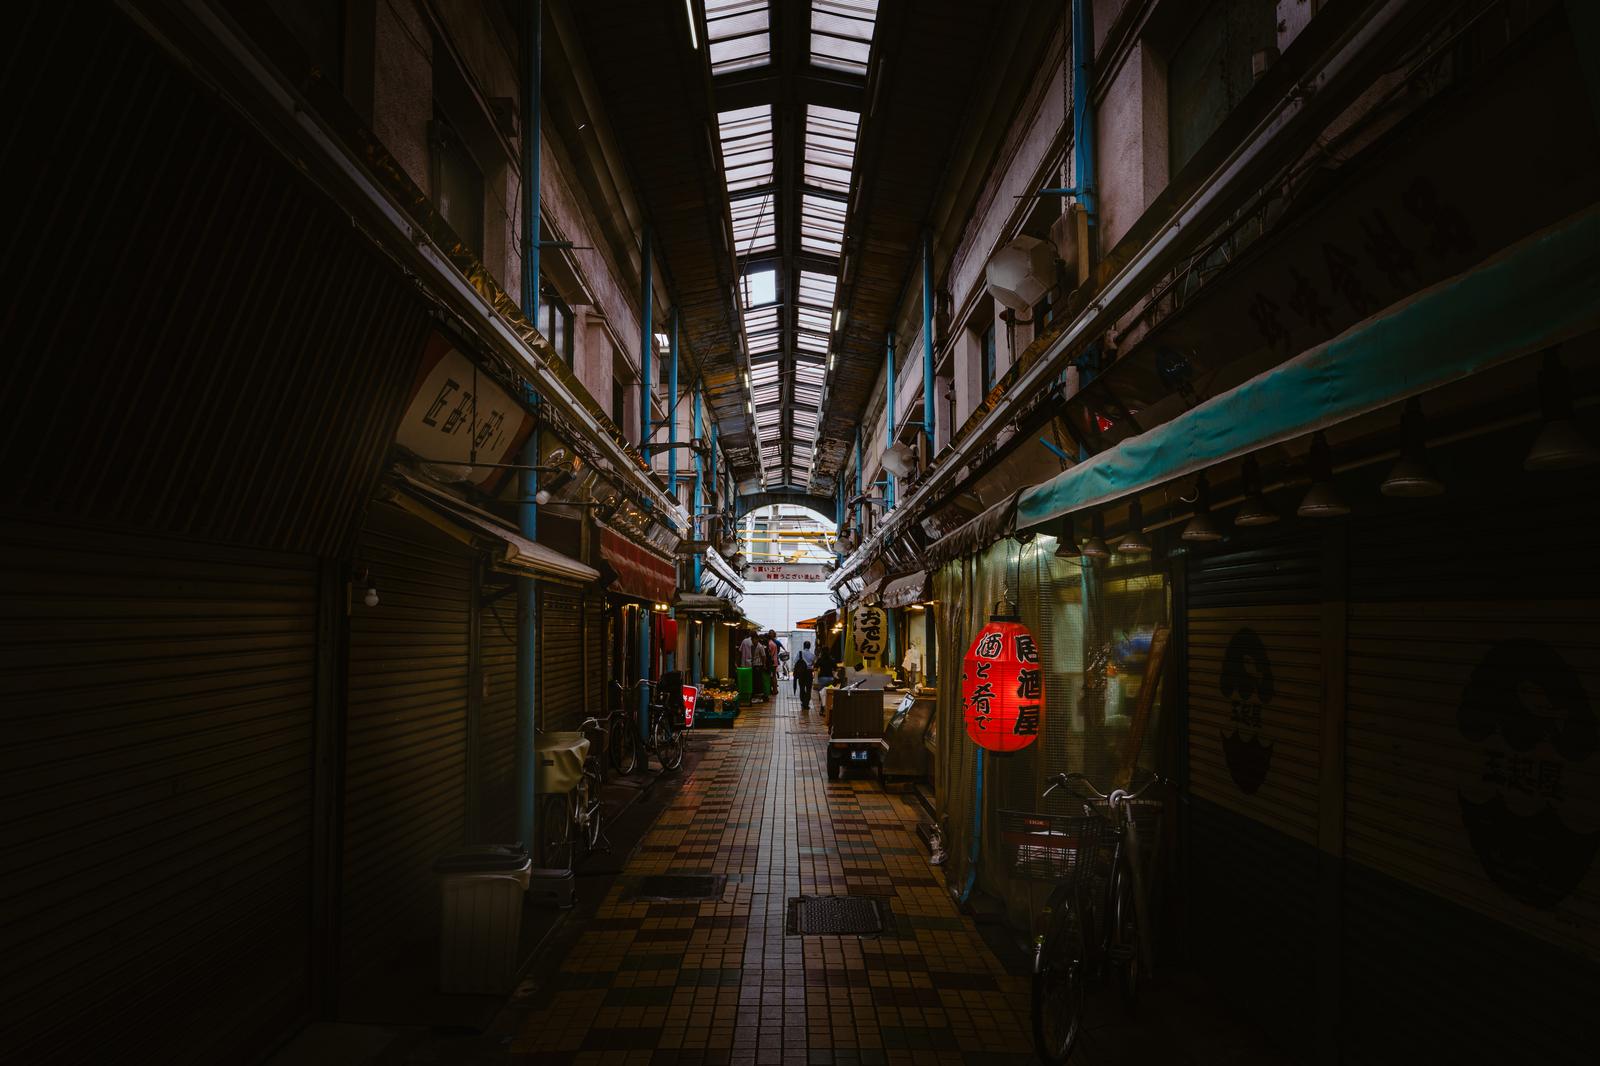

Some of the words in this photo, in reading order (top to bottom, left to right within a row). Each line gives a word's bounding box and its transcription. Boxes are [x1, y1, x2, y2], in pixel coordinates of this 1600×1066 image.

[860, 610, 880, 654] おでん
[970, 632, 1003, 731] 酒と肴で
[1013, 633, 1041, 735] 居酒屋
